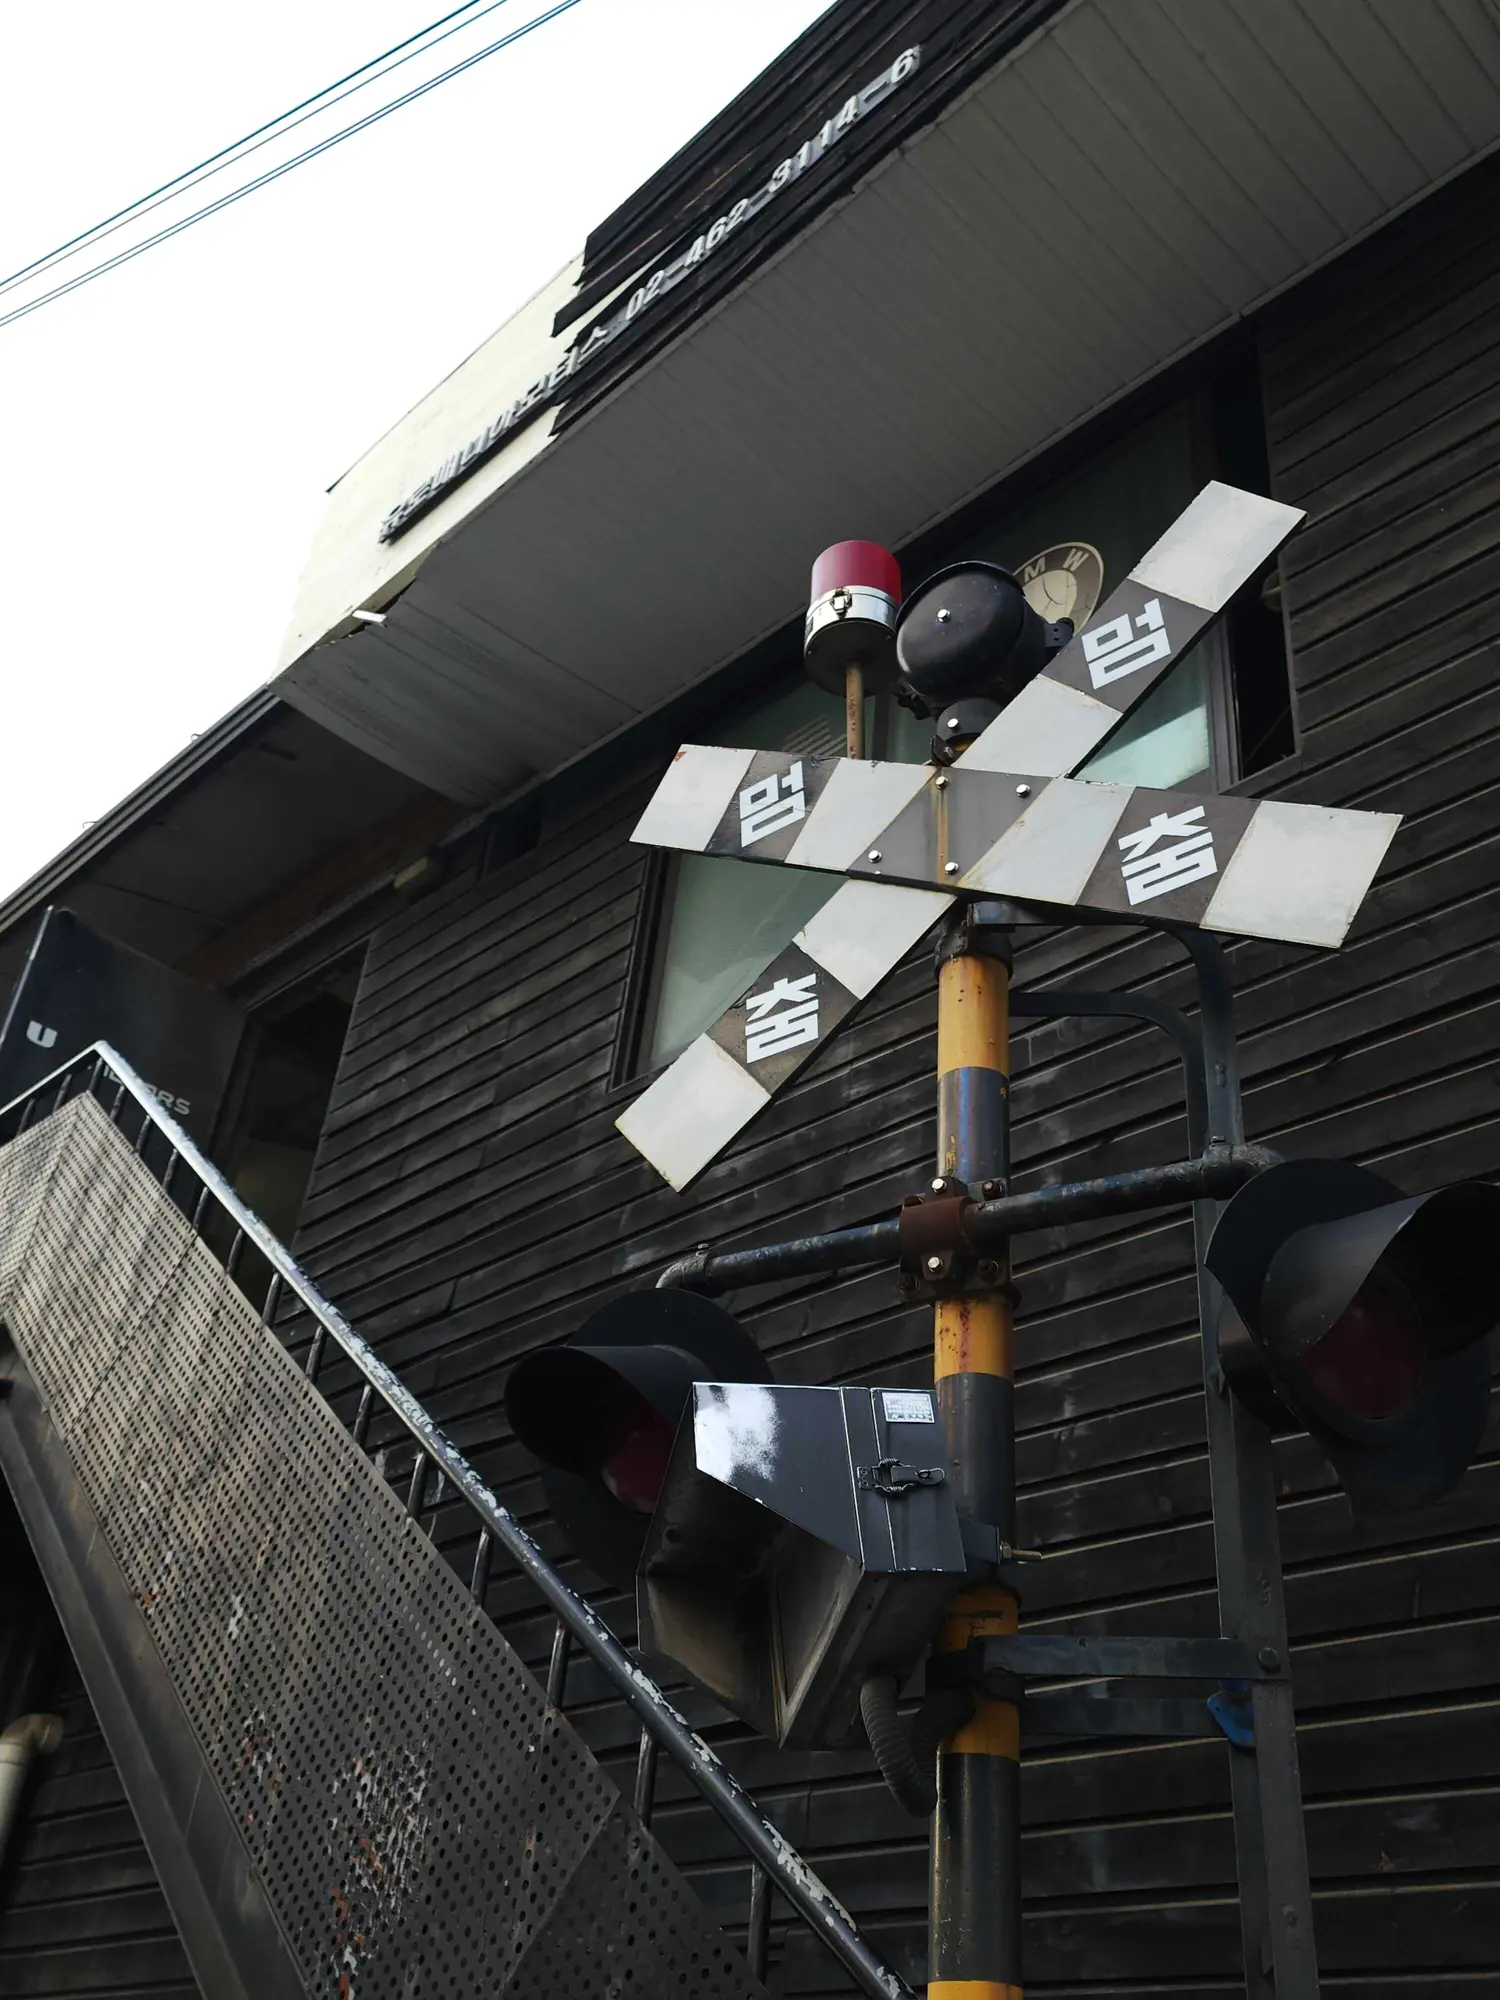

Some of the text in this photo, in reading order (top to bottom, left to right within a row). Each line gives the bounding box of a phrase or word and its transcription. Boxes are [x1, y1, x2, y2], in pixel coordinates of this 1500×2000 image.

[1024, 548, 1090, 583] MW
[739, 760, 1219, 907] 멈 춤
[745, 598, 1172, 1065] 멈 춤
